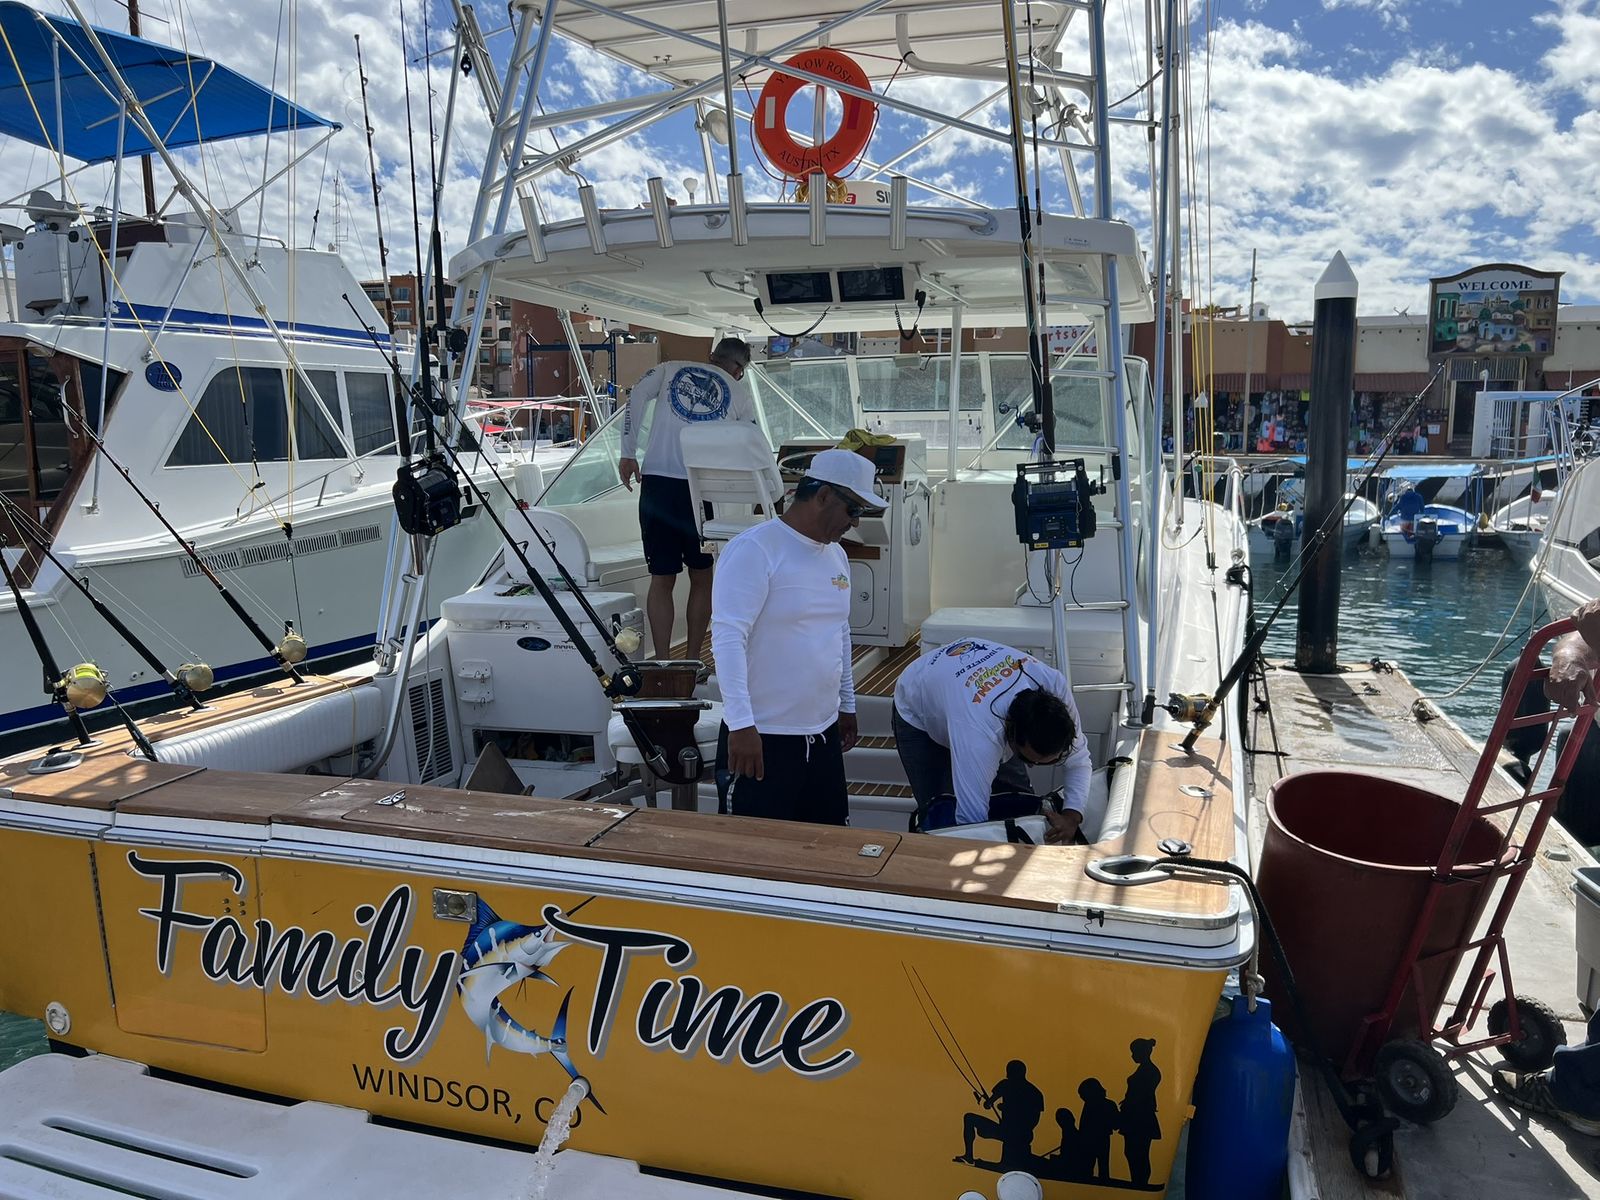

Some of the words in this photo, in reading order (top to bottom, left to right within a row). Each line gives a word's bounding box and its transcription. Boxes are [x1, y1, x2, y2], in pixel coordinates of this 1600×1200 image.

[776, 58, 826, 84] YLOW
[826, 61, 854, 84] ROSE
[778, 149, 819, 168] AUSTIN
[823, 146, 841, 162] TX
[1458, 280, 1533, 291] WELCOME
[955, 667, 966, 678] DE
[972, 677, 1003, 704] TUNA
[127, 849, 458, 1061] Family
[541, 903, 857, 1076] Time
[352, 1063, 522, 1124] WINDSOR,
